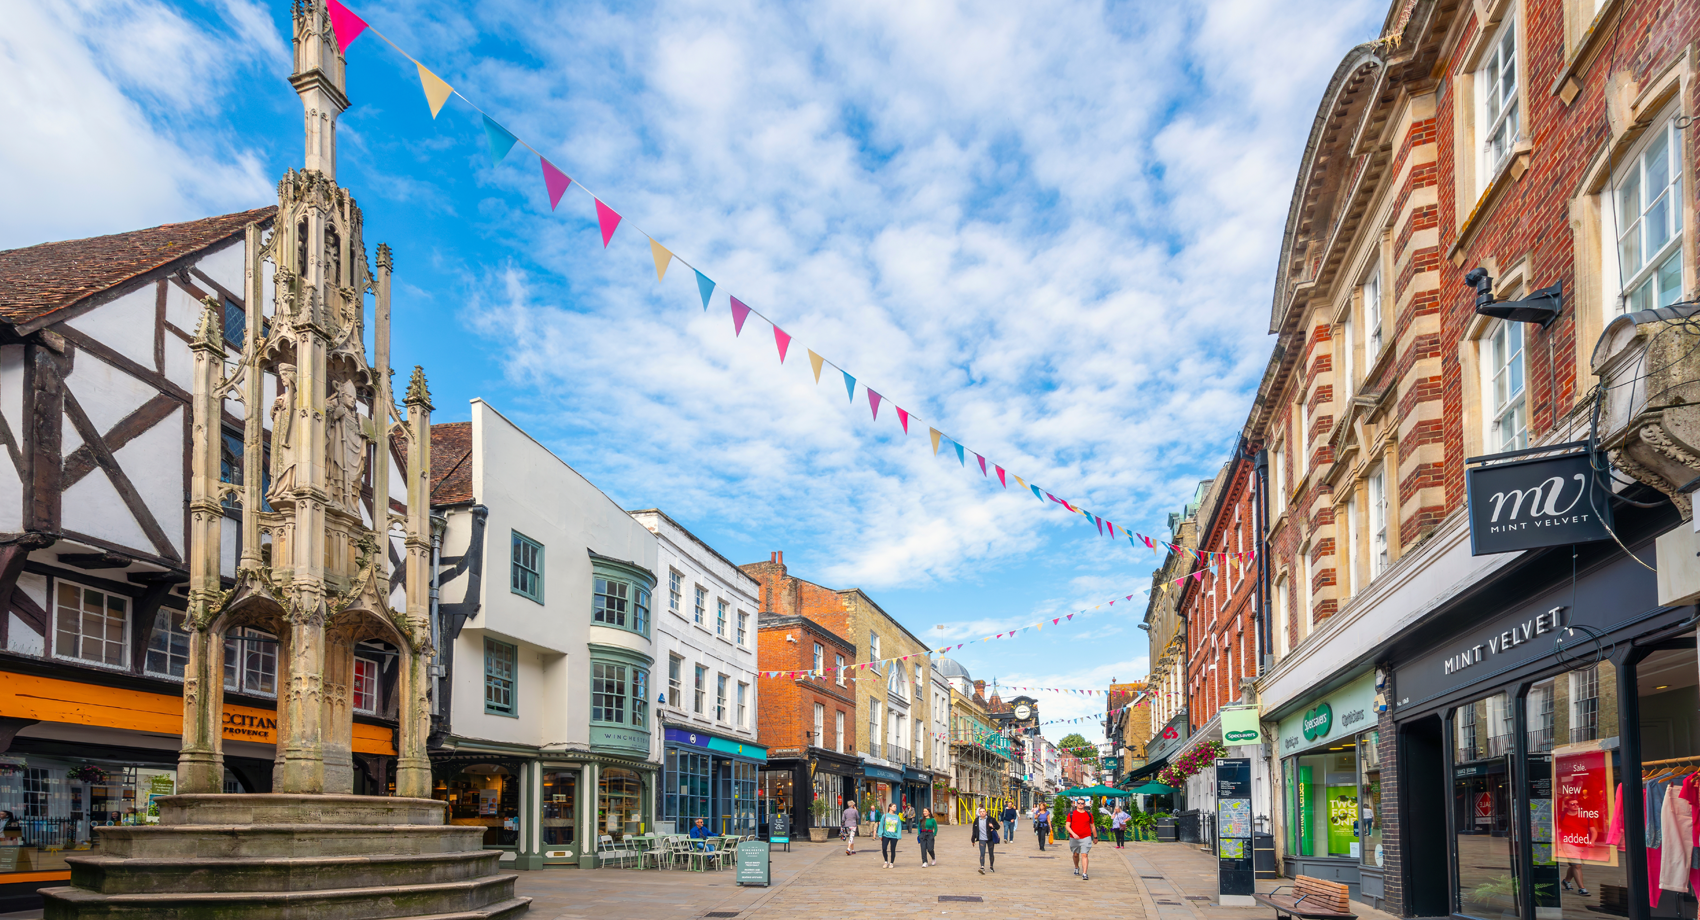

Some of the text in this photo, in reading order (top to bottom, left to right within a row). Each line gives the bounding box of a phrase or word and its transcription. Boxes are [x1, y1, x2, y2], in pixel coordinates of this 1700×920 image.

[1490, 514, 1589, 533] MINT VELVET
[1444, 606, 1564, 675] MINT VELVET
[1304, 713, 1327, 733] Specsavers
[223, 726, 269, 737] PROVENCE
[1227, 732, 1256, 740] Specsavers
[1573, 764, 1586, 772] Sale.
[1562, 784, 1581, 795] New
[1332, 808, 1357, 817] FOR
[1578, 807, 1599, 818] lines
[1563, 833, 1592, 845] added.
